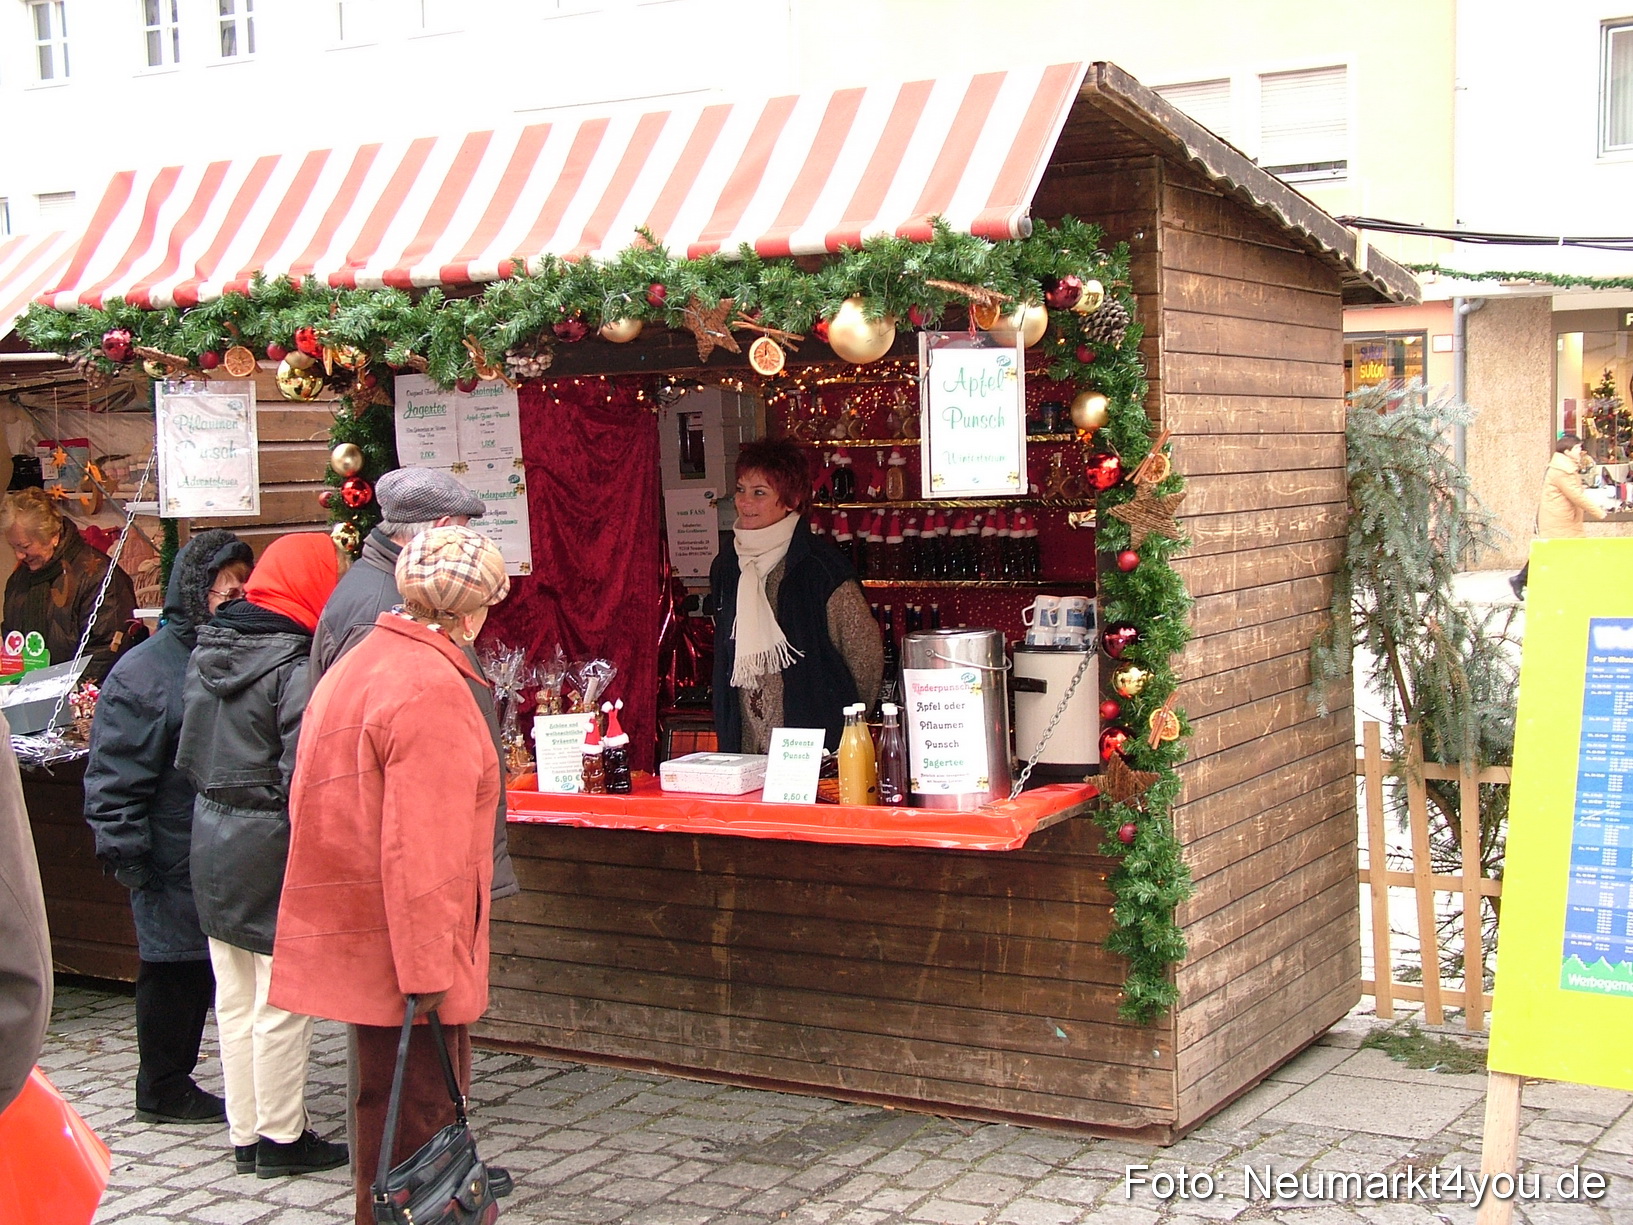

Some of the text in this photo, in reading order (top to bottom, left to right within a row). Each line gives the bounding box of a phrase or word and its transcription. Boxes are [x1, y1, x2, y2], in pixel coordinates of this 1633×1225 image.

[942, 366, 1004, 398] Apfel
[942, 405, 1005, 430] Punsch
[172, 414, 239, 434] Pflaumen
[912, 682, 970, 695] Kinderpunsch
[916, 701, 966, 713] Apfel oder
[919, 720, 964, 731] Pflaumen
[781, 738, 815, 748] Advents
[924, 739, 960, 750] Punsch
[782, 751, 811, 761] Punsch
